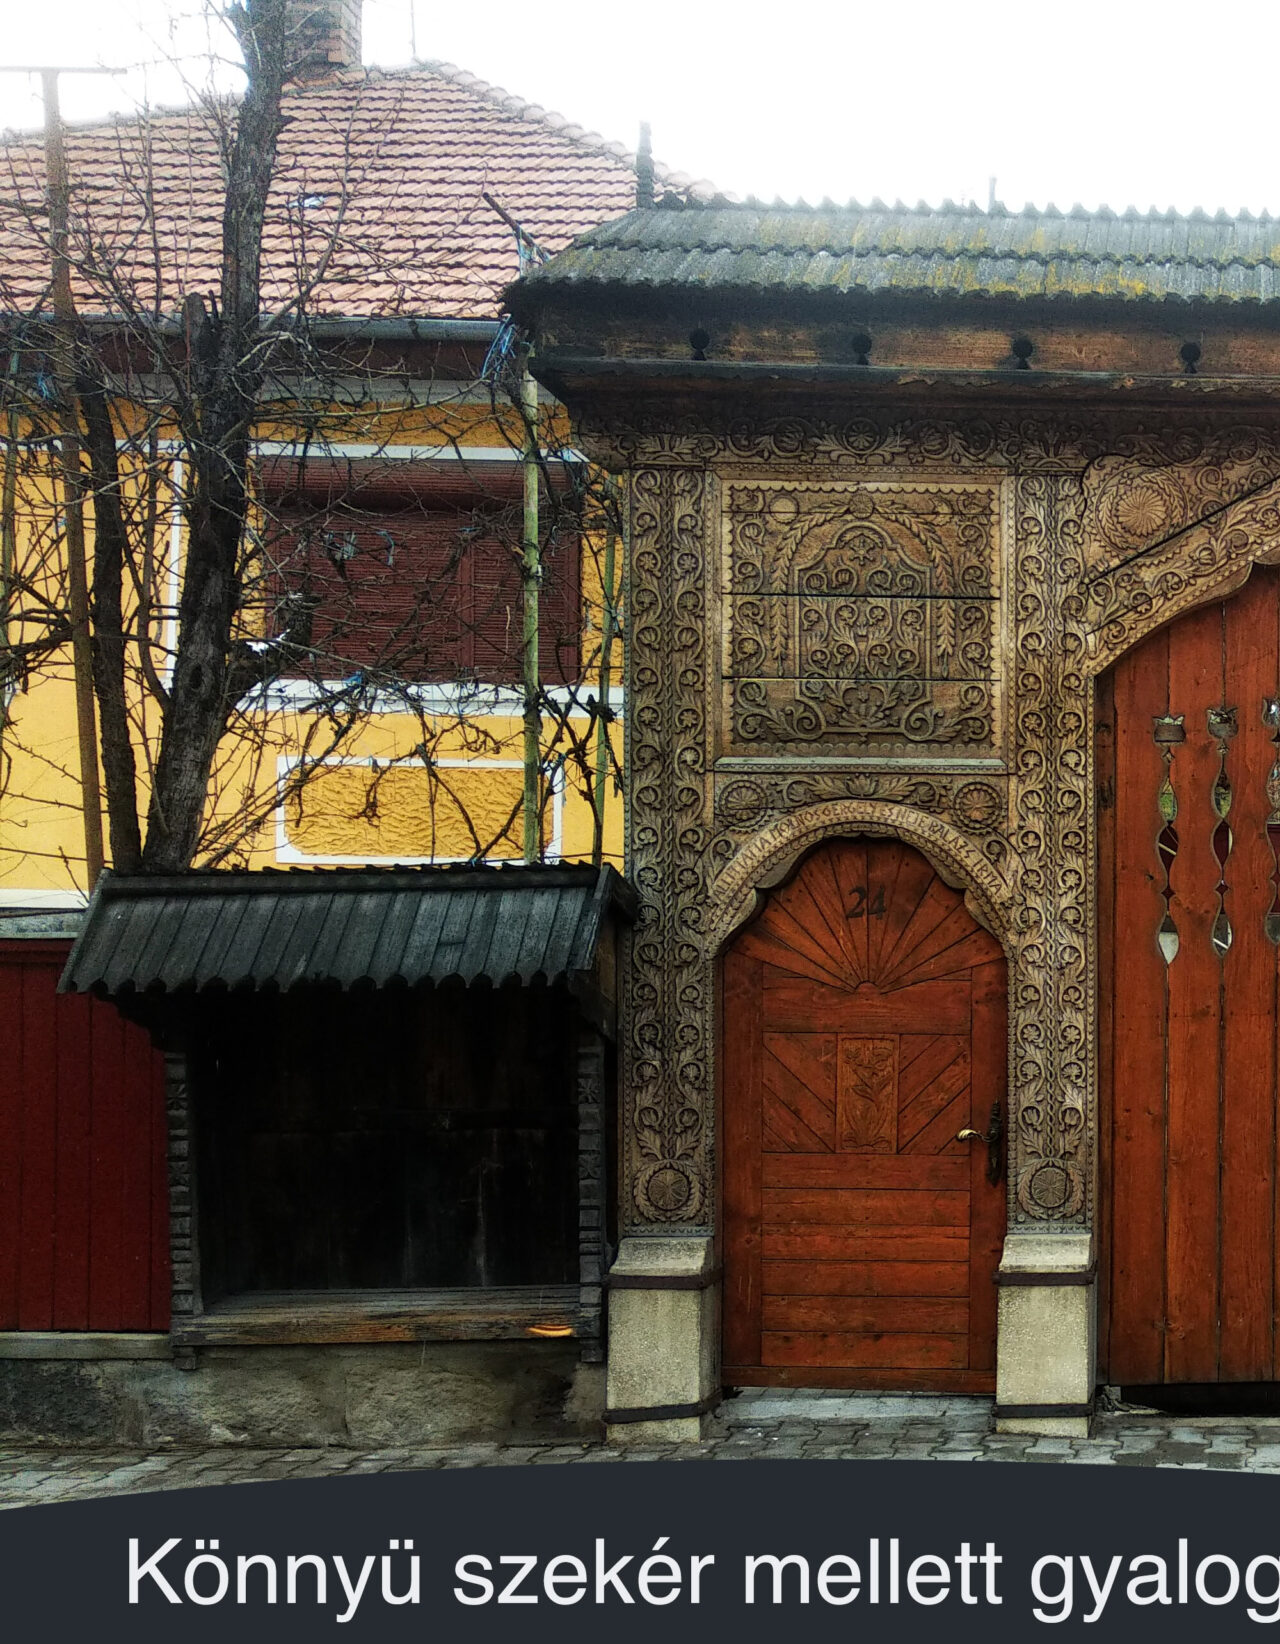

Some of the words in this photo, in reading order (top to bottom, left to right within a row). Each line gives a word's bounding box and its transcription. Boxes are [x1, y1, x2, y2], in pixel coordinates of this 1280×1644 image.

[822, 801, 878, 818] GERGELY
[973, 858, 1002, 896] IRMA
[846, 885, 887, 920] 24
